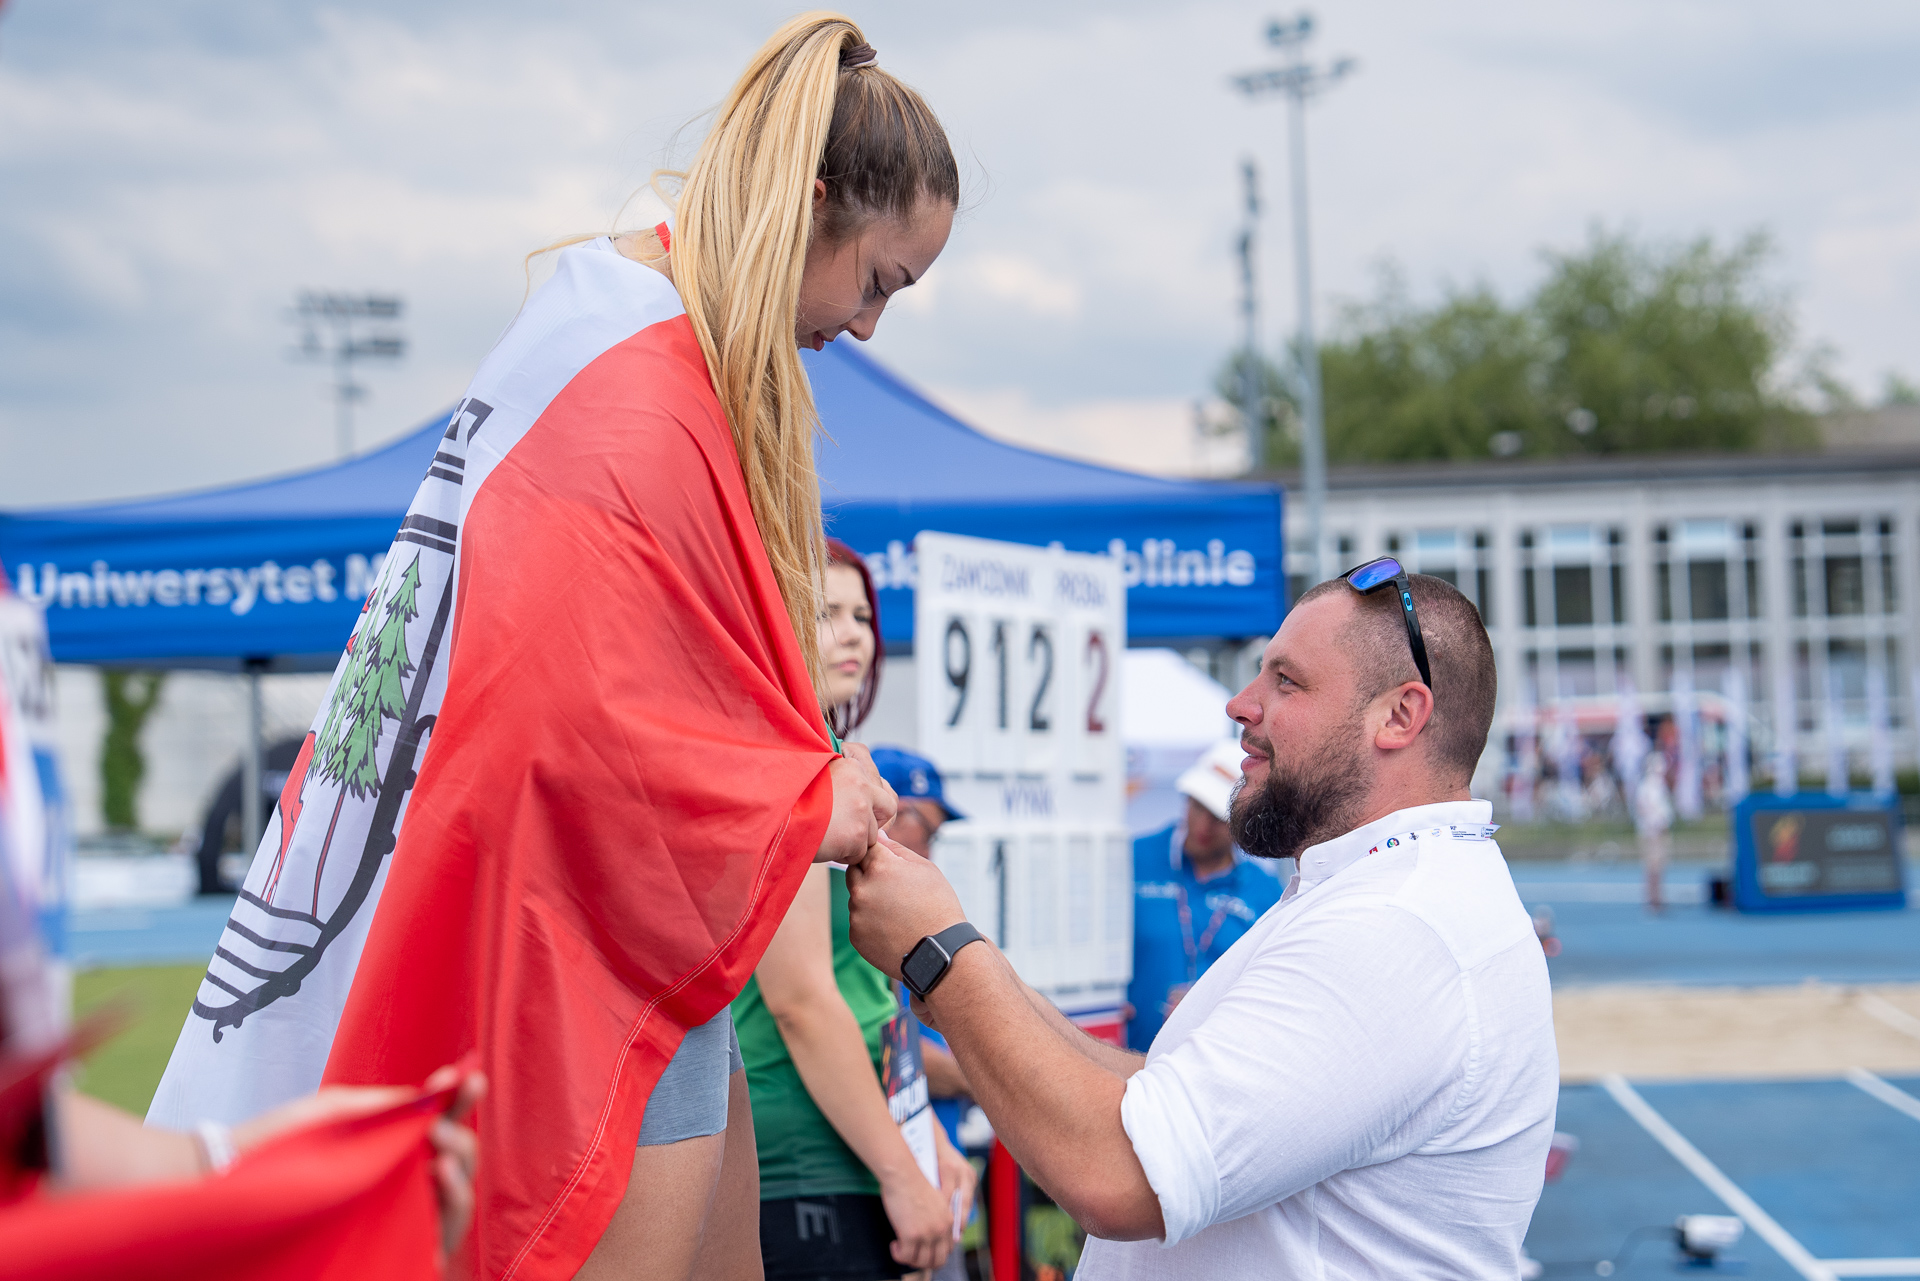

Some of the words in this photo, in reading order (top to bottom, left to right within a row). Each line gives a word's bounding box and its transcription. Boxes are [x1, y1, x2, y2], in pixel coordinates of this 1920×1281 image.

[17, 560, 338, 617] Uniwersytet
[944, 615, 1054, 733] 912
[1080, 630, 1109, 733] 2
